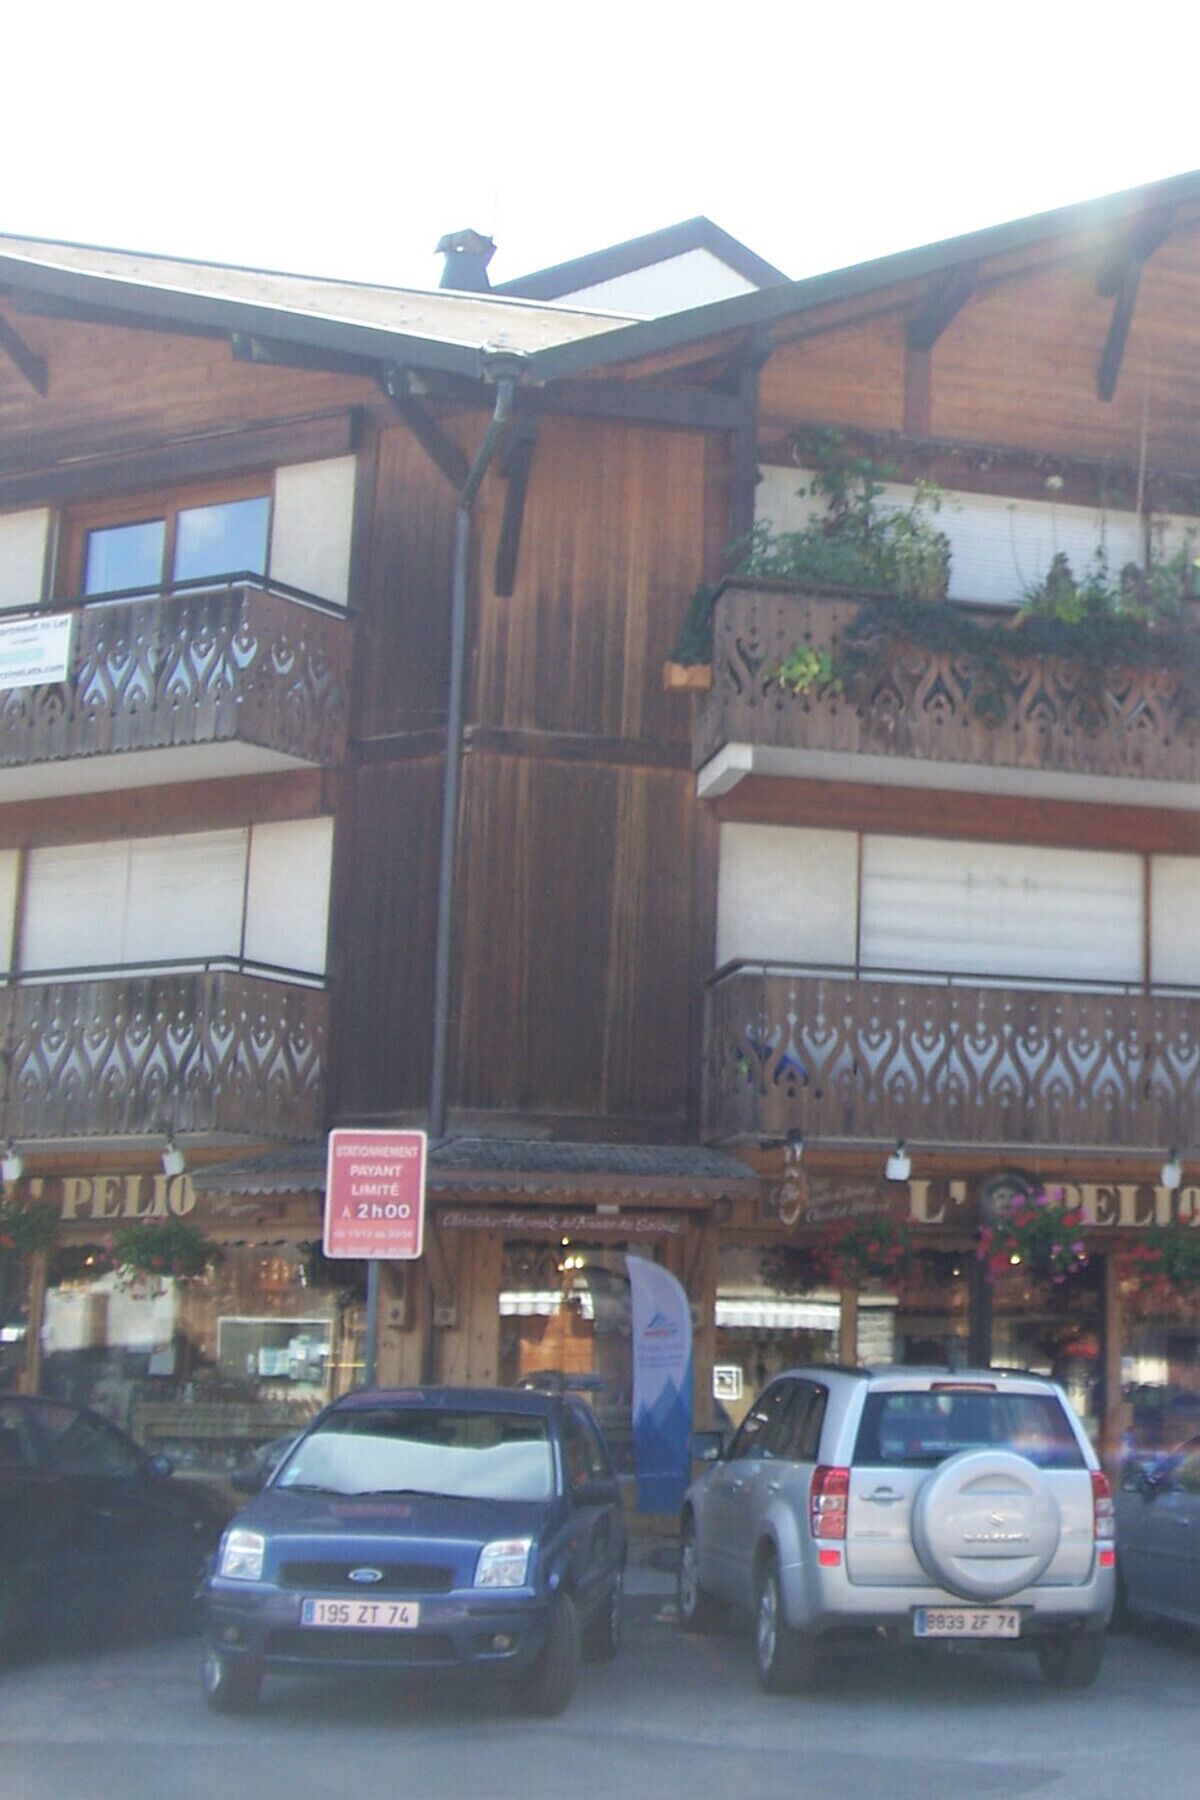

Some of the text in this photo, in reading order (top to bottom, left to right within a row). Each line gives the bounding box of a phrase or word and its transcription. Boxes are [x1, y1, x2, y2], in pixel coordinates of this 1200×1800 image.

[336, 1145, 418, 1158] STATIONNEMENT
[350, 1165, 402, 1177] PAYANT
[60, 1172, 197, 1219] PELIO
[351, 1182, 400, 1196] LIMITÉ
[318, 1603, 410, 1624] 195 ZT 74
[970, 1614, 991, 1631] ZF
[996, 1614, 1017, 1631] 74
